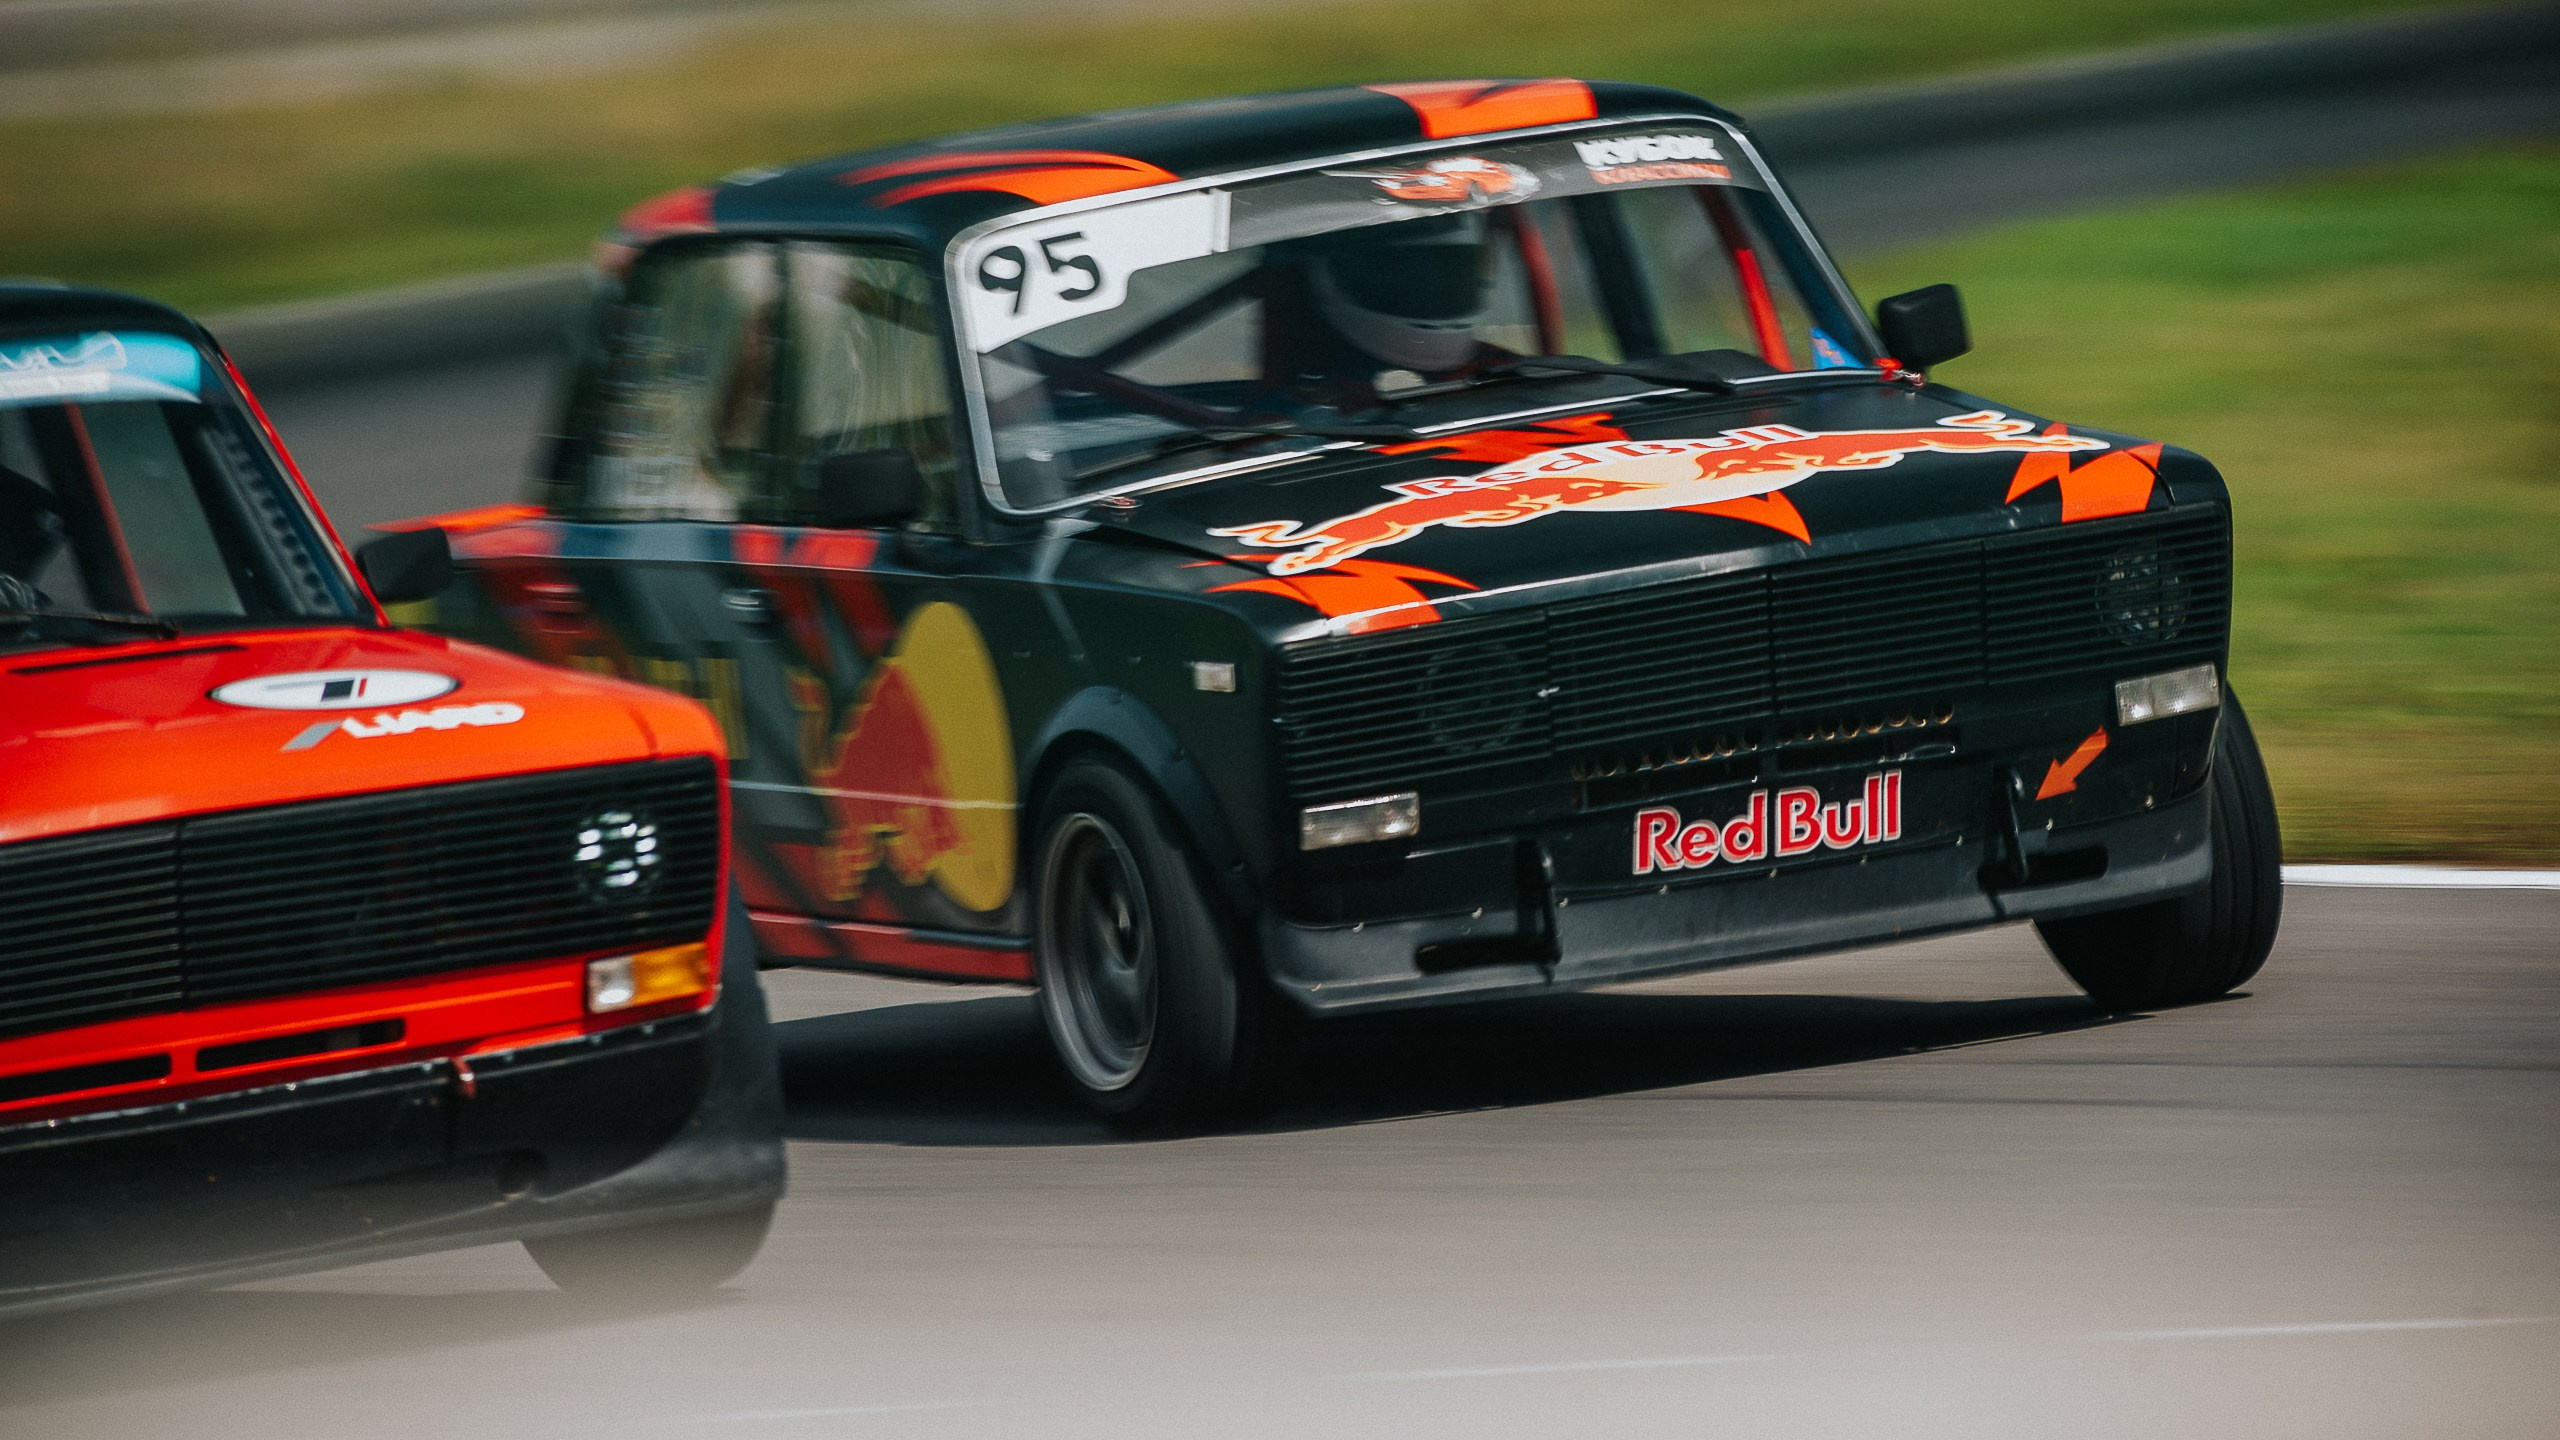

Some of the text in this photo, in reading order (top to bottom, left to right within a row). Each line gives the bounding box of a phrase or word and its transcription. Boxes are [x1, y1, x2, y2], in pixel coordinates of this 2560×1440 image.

[979, 231, 1100, 314] 95
[1396, 426, 1806, 496] Red Bull
[1633, 769, 1902, 875] Red Bull
